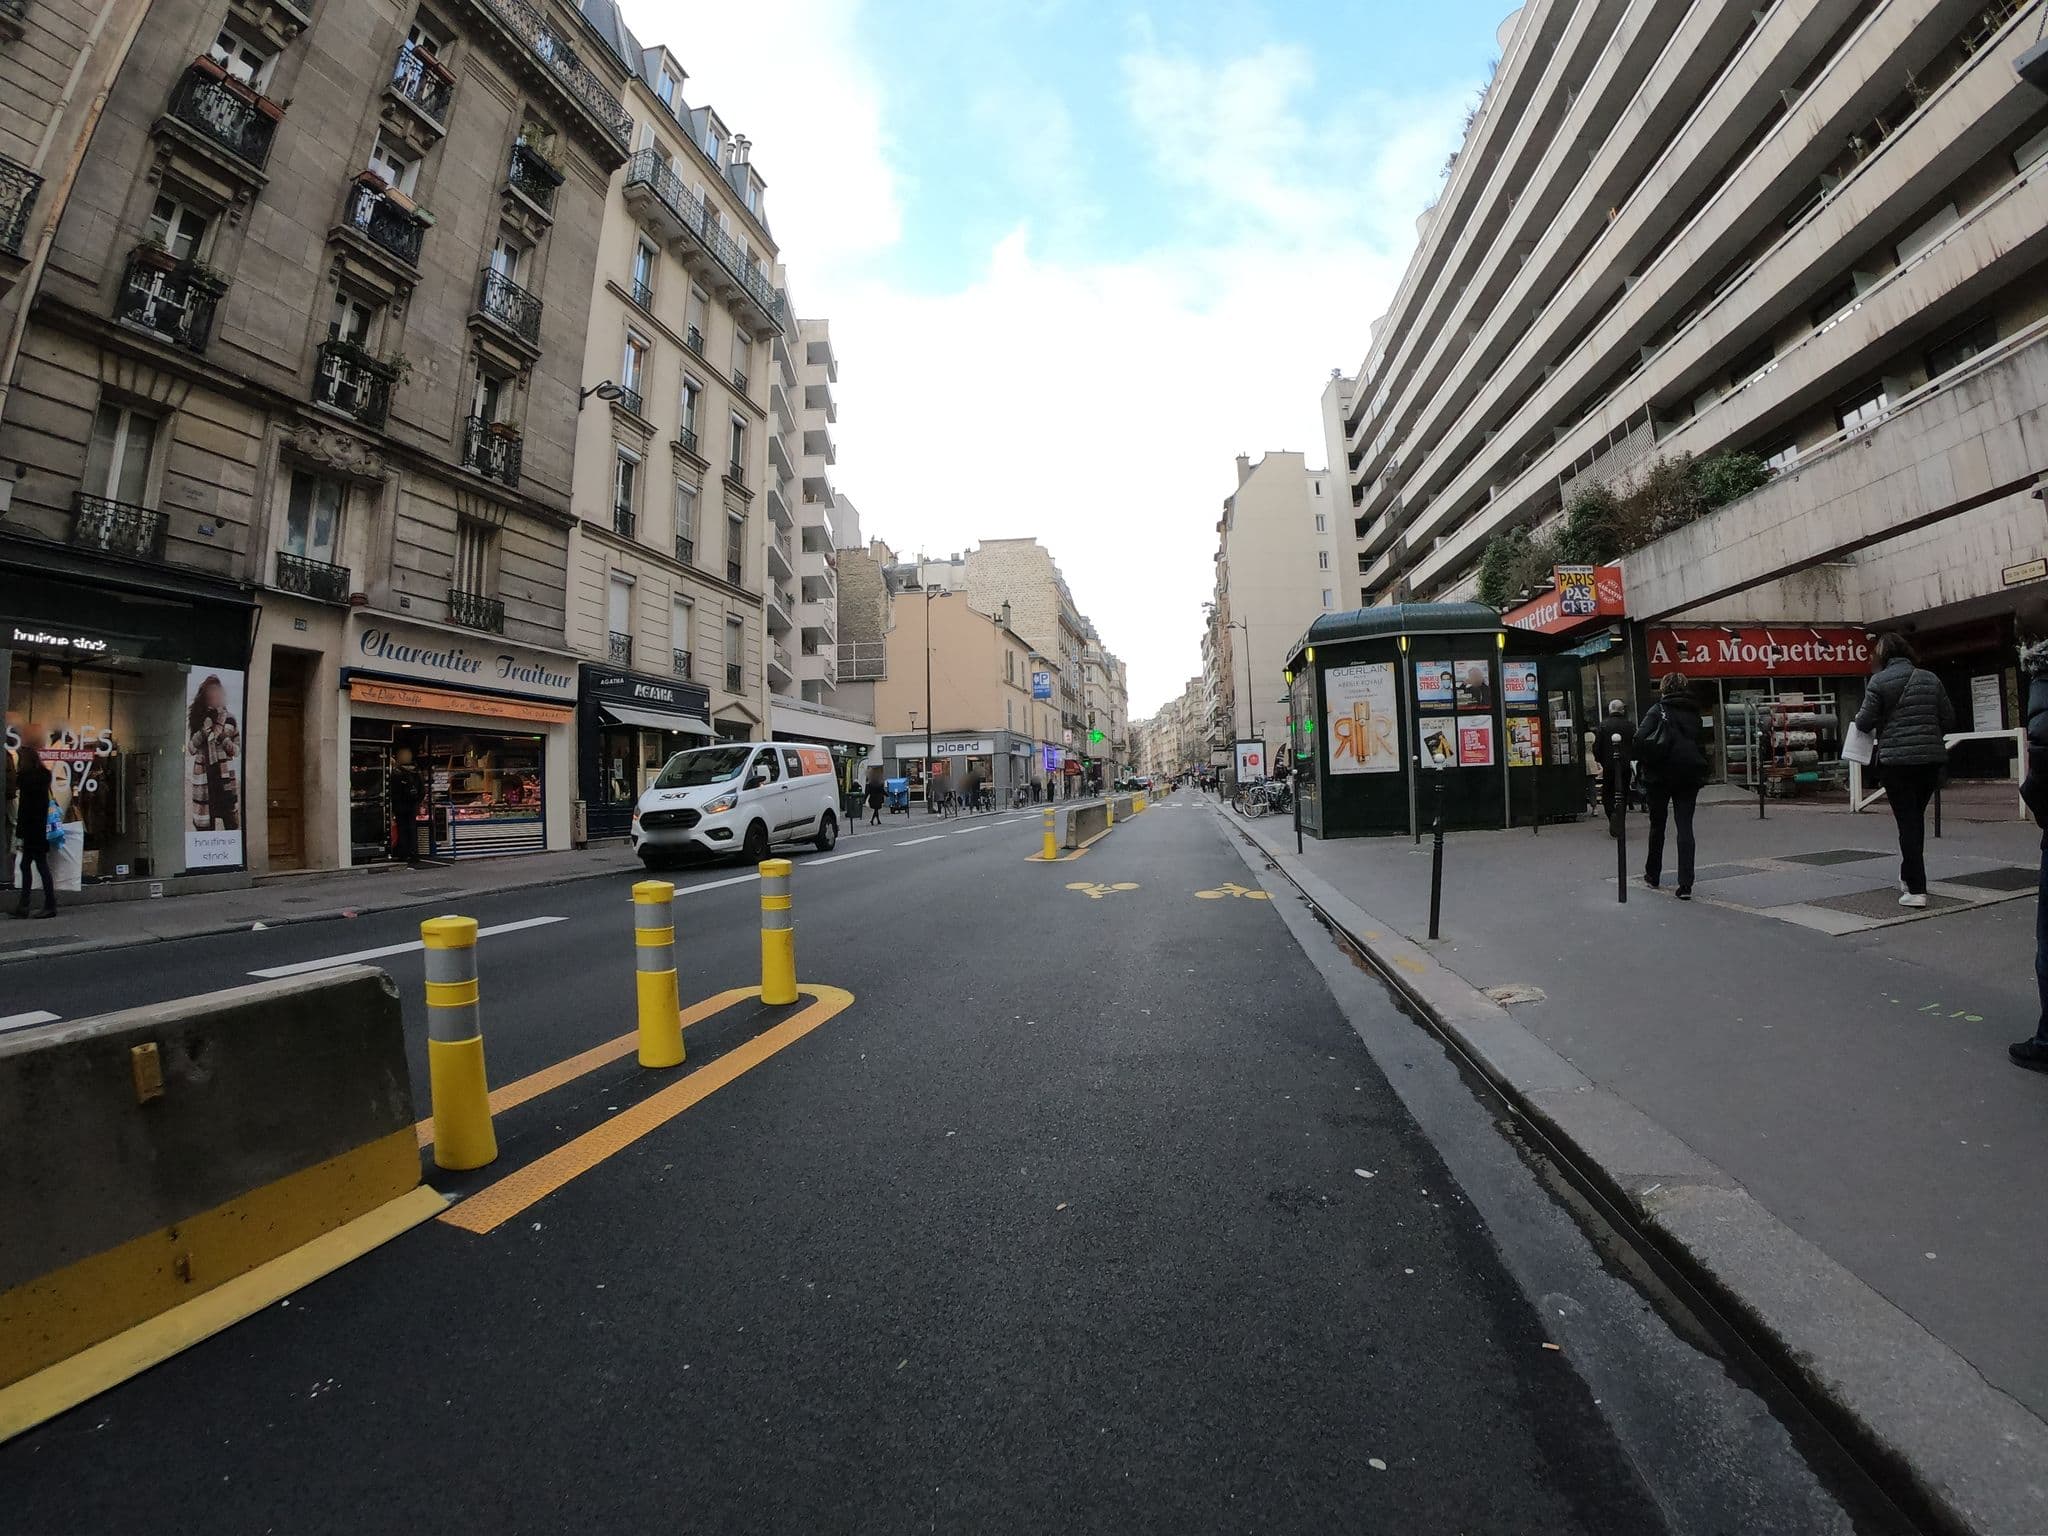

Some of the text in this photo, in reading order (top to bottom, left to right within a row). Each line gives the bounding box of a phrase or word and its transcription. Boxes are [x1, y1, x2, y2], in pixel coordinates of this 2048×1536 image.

[1559, 573, 1595, 586] PARIS
[1566, 587, 1590, 600] PAS
[1562, 600, 1595, 613] CHER
[360, 628, 571, 688] Charcutier Traiteur
[1651, 638, 1868, 669] A La Moquetterie
[1332, 665, 1388, 677] GUERLAIN
[1041, 674, 1049, 684] P
[1419, 681, 1440, 690] STRESS
[634, 684, 674, 702] AGATHA
[3, 725, 112, 757] SDES
[937, 741, 979, 754] picard
